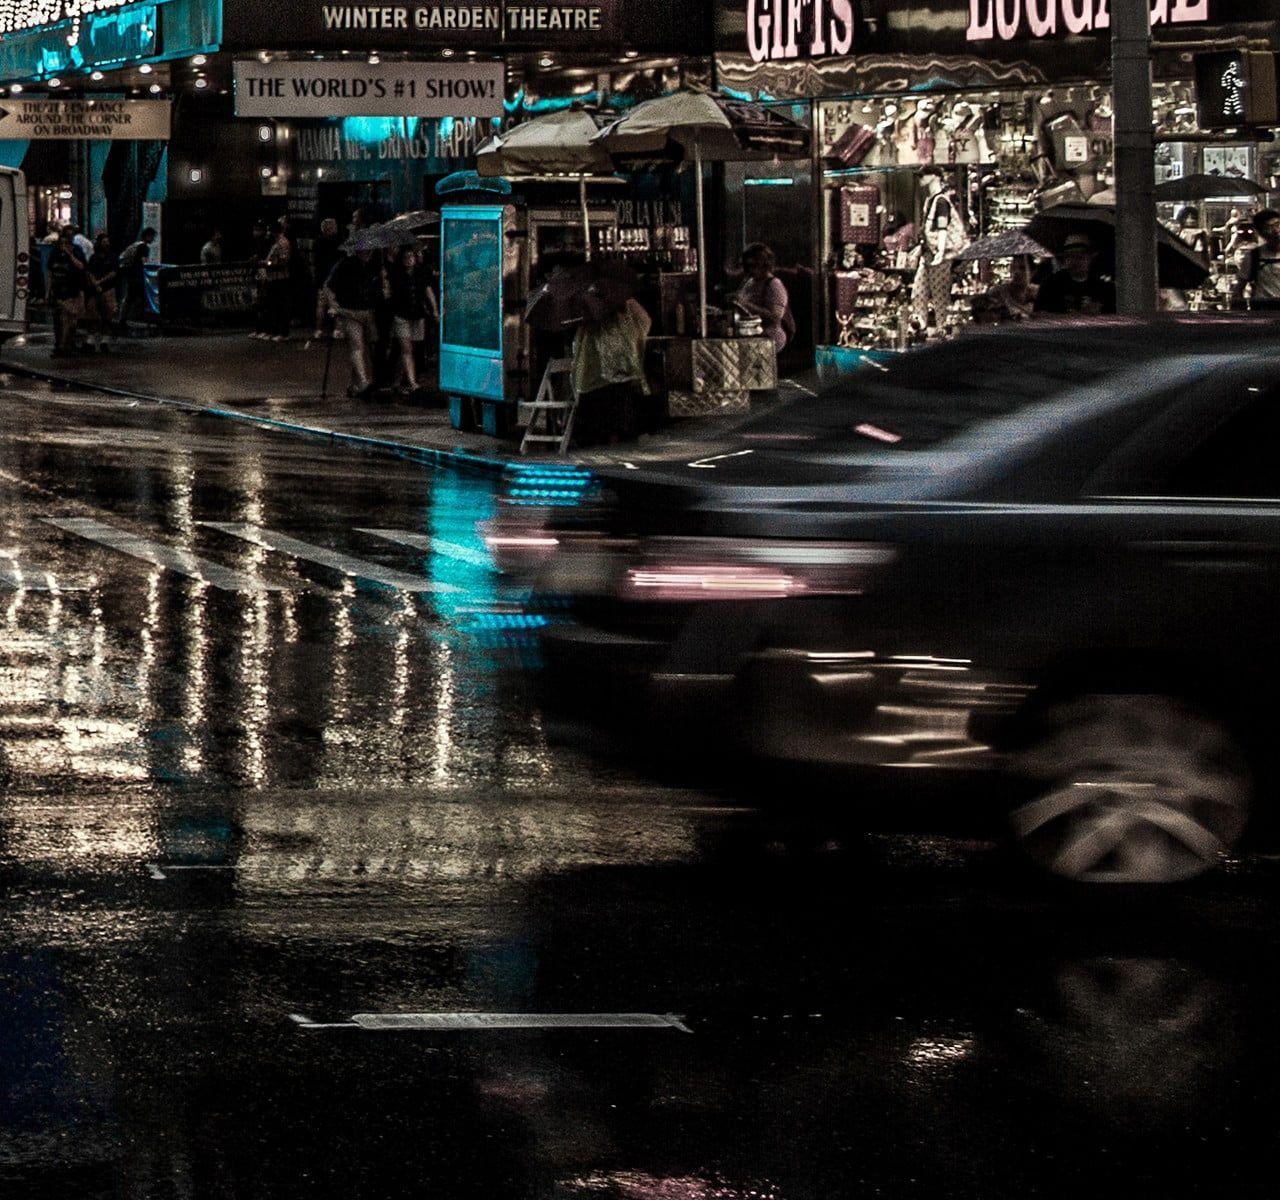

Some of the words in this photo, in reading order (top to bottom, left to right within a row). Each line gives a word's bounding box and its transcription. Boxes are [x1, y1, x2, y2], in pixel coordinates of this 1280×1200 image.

[323, 6, 407, 30] WINTER
[414, 6, 499, 31] GARDEN
[507, 6, 601, 31] THEATRE
[245, 78, 286, 98] THE
[292, 77, 386, 98] WORLD'S
[393, 79, 417, 98] #1
[426, 79, 496, 99] SHOW!
[16, 114, 61, 124] AROUND
[34, 125, 53, 136] ON
[55, 125, 113, 136] BROADWAY
